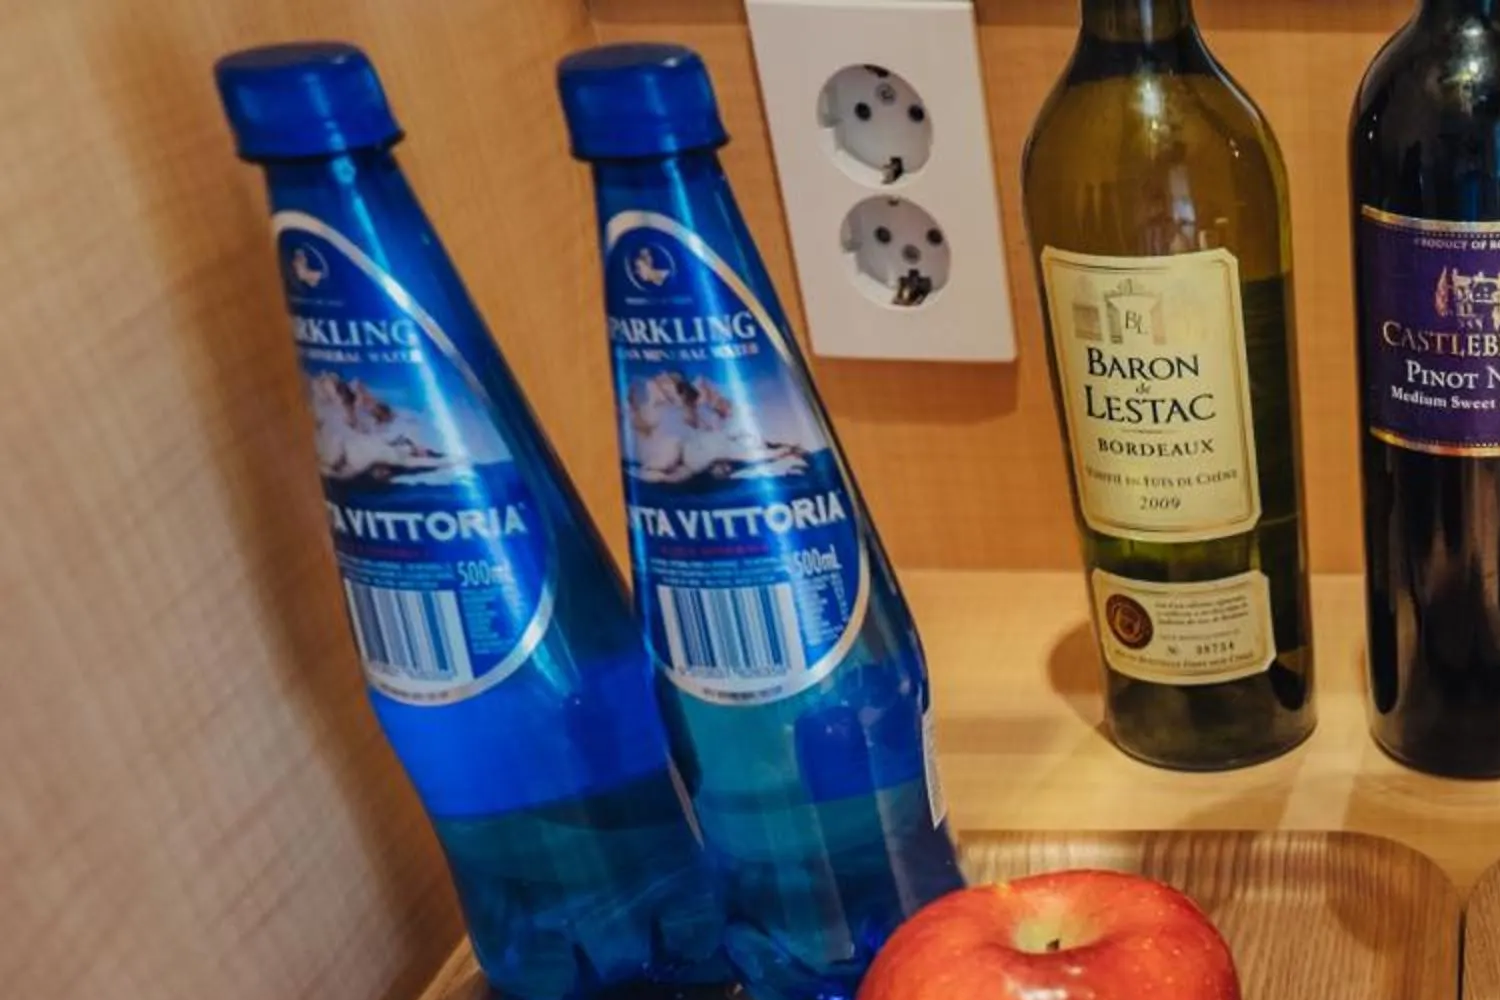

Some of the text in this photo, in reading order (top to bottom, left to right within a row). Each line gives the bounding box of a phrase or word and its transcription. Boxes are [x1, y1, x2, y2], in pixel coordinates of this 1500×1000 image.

[609, 310, 756, 344] PARKLING
[1086, 345, 1199, 381] BARON
[1405, 359, 1479, 389] PINOT
[1084, 384, 1216, 425] LESTAC
[1391, 385, 1447, 409] Medium
[1451, 396, 1495, 410] Sweet
[1097, 437, 1215, 458] BORDEAUX
[676, 491, 848, 539] VITTORIA
[1139, 496, 1182, 511] 2009
[346, 504, 528, 542] VITTORIA
